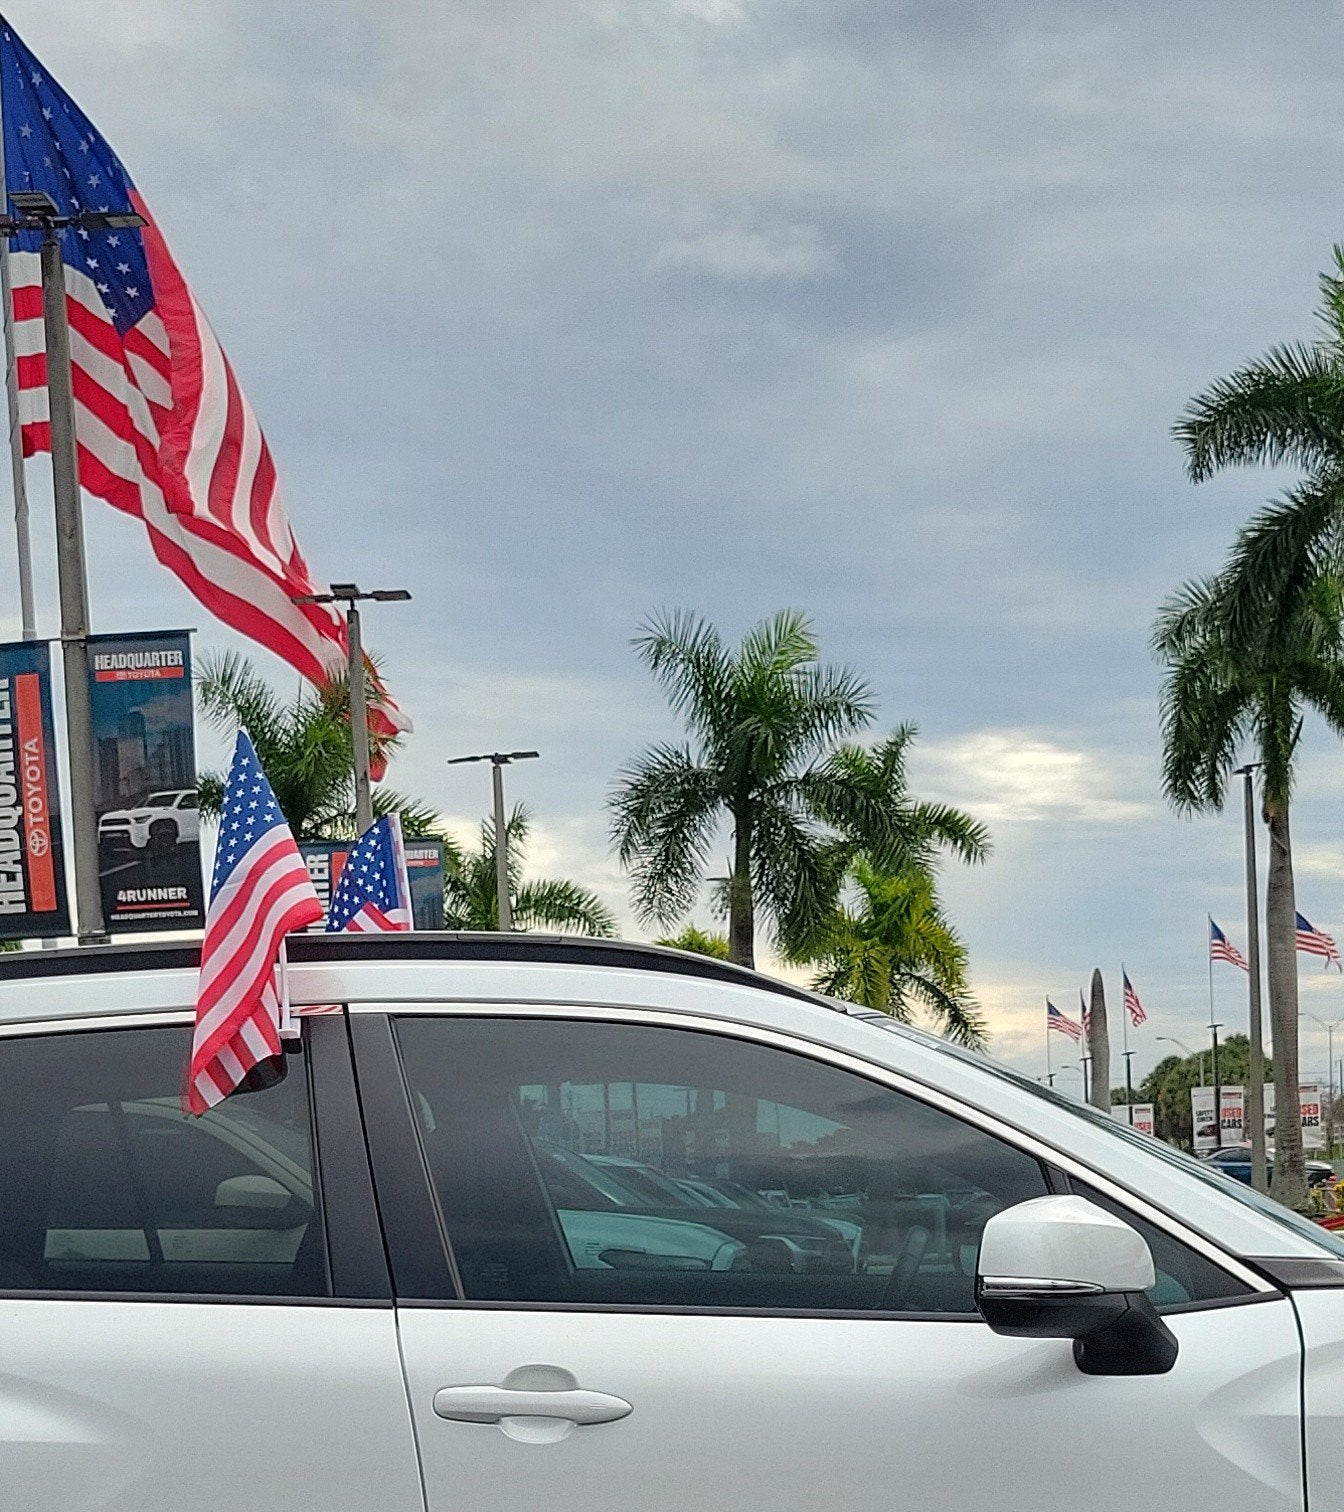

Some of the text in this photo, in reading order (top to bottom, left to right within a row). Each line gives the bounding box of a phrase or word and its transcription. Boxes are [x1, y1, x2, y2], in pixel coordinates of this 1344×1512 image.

[94, 650, 183, 670] HEADQUARTER
[127, 669, 162, 679] TOYOTA
[23, 736, 46, 826] TOYOTA
[117, 887, 188, 902] 4RUNNER
[1221, 1107, 1242, 1118] USED
[1300, 1104, 1319, 1115] SED
[1221, 1118, 1242, 1129] CARS
[1301, 1116, 1319, 1127] ARS
